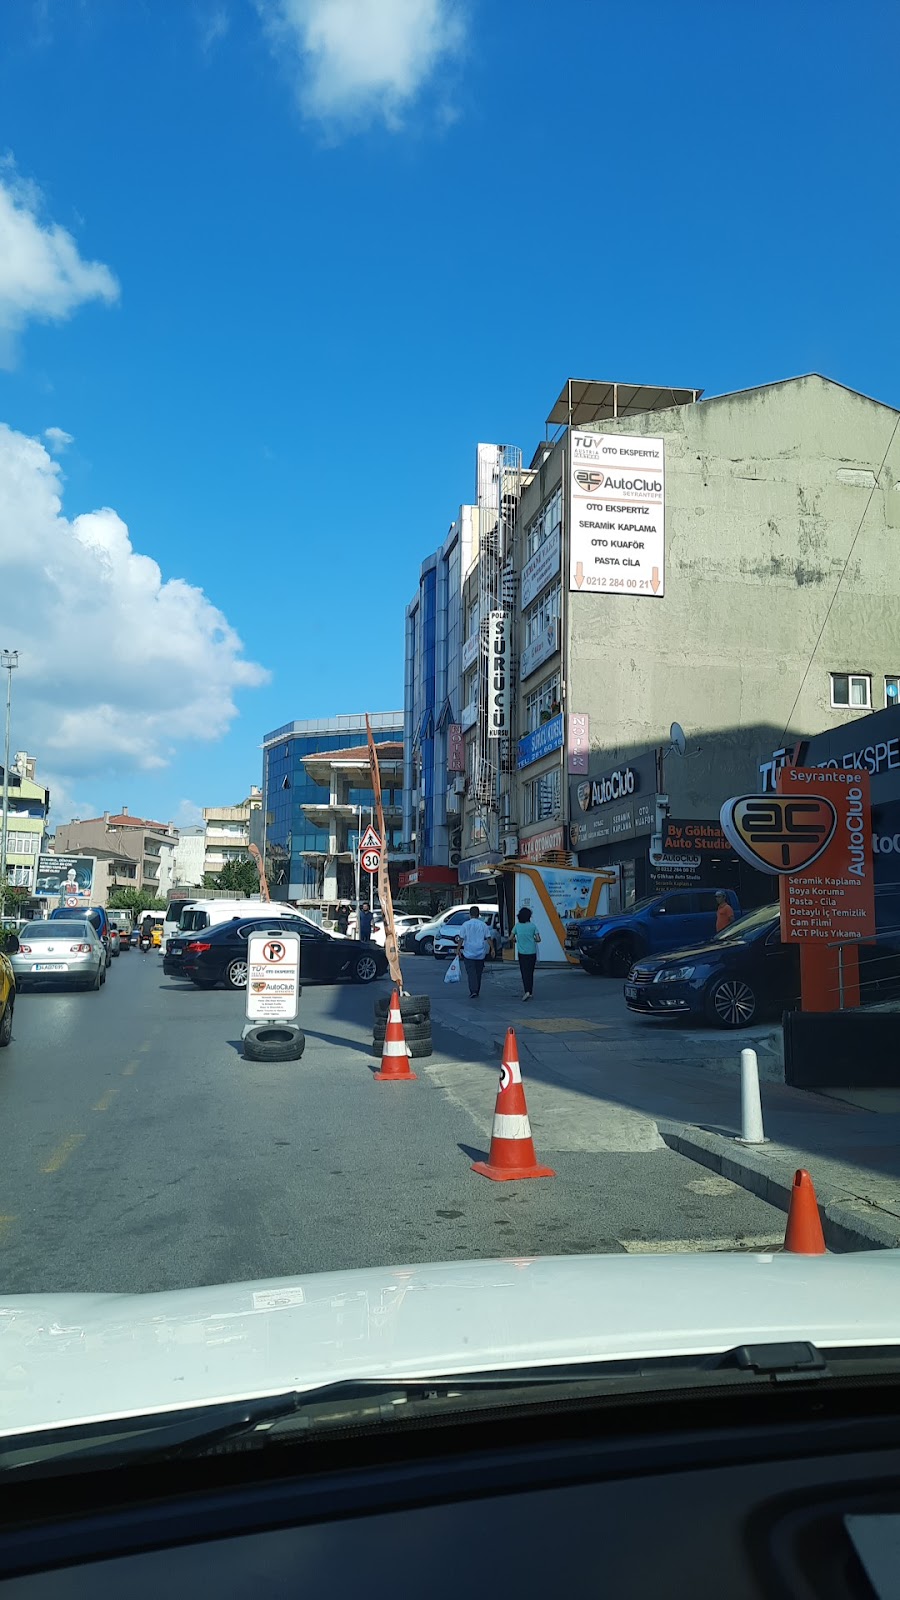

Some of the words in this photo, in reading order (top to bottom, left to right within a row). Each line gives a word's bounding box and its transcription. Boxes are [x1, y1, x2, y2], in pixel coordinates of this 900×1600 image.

[574, 435, 604, 448] TÜV
[602, 447, 618, 455] OTO
[620, 448, 660, 458] EKSPERTİZ
[604, 477, 662, 492] AutoClub
[622, 490, 662, 498] SEYRANTEPE
[586, 503, 603, 512] OTO
[605, 504, 650, 514] EKSPERTİZ
[579, 520, 616, 530] SERAMİK
[618, 524, 657, 533] KAPLAMA
[591, 539, 608, 547] OTO
[610, 540, 644, 550] KUAFÖR
[594, 556, 620, 566] PASTA
[622, 558, 640, 566] CİLA
[586, 576, 606, 586] 0212
[609, 578, 624, 587] 284
[626, 579, 637, 588] 00
[639, 580, 648, 588] 21
[494, 620, 506, 727] SÜRÜCÜ
[790, 770, 862, 784] Seyrantepe
[592, 768, 634, 806] AutoClub
[638, 806, 648, 815] OTO
[668, 824, 682, 838] By
[846, 787, 866, 878] AutoClub
[665, 838, 692, 848] Auto
[694, 838, 732, 850] Studio
[365, 855, 378, 866] 30
[663, 854, 698, 862] AutoClub
[788, 876, 823, 885] Seramik
[825, 877, 862, 887] Kaplama
[789, 887, 810, 897] Boya
[812, 888, 844, 896] Koruma
[790, 898, 813, 906] Pasta
[820, 898, 836, 906] Cila
[790, 908, 820, 918] Detaylı
[822, 906, 830, 918] İç
[832, 908, 866, 917] Temizlik
[790, 918, 809, 926] Cam
[810, 918, 832, 926] Filmi
[790, 929, 808, 937] ACT
[810, 929, 829, 937] Plus
[831, 930, 862, 938] Yıkama
